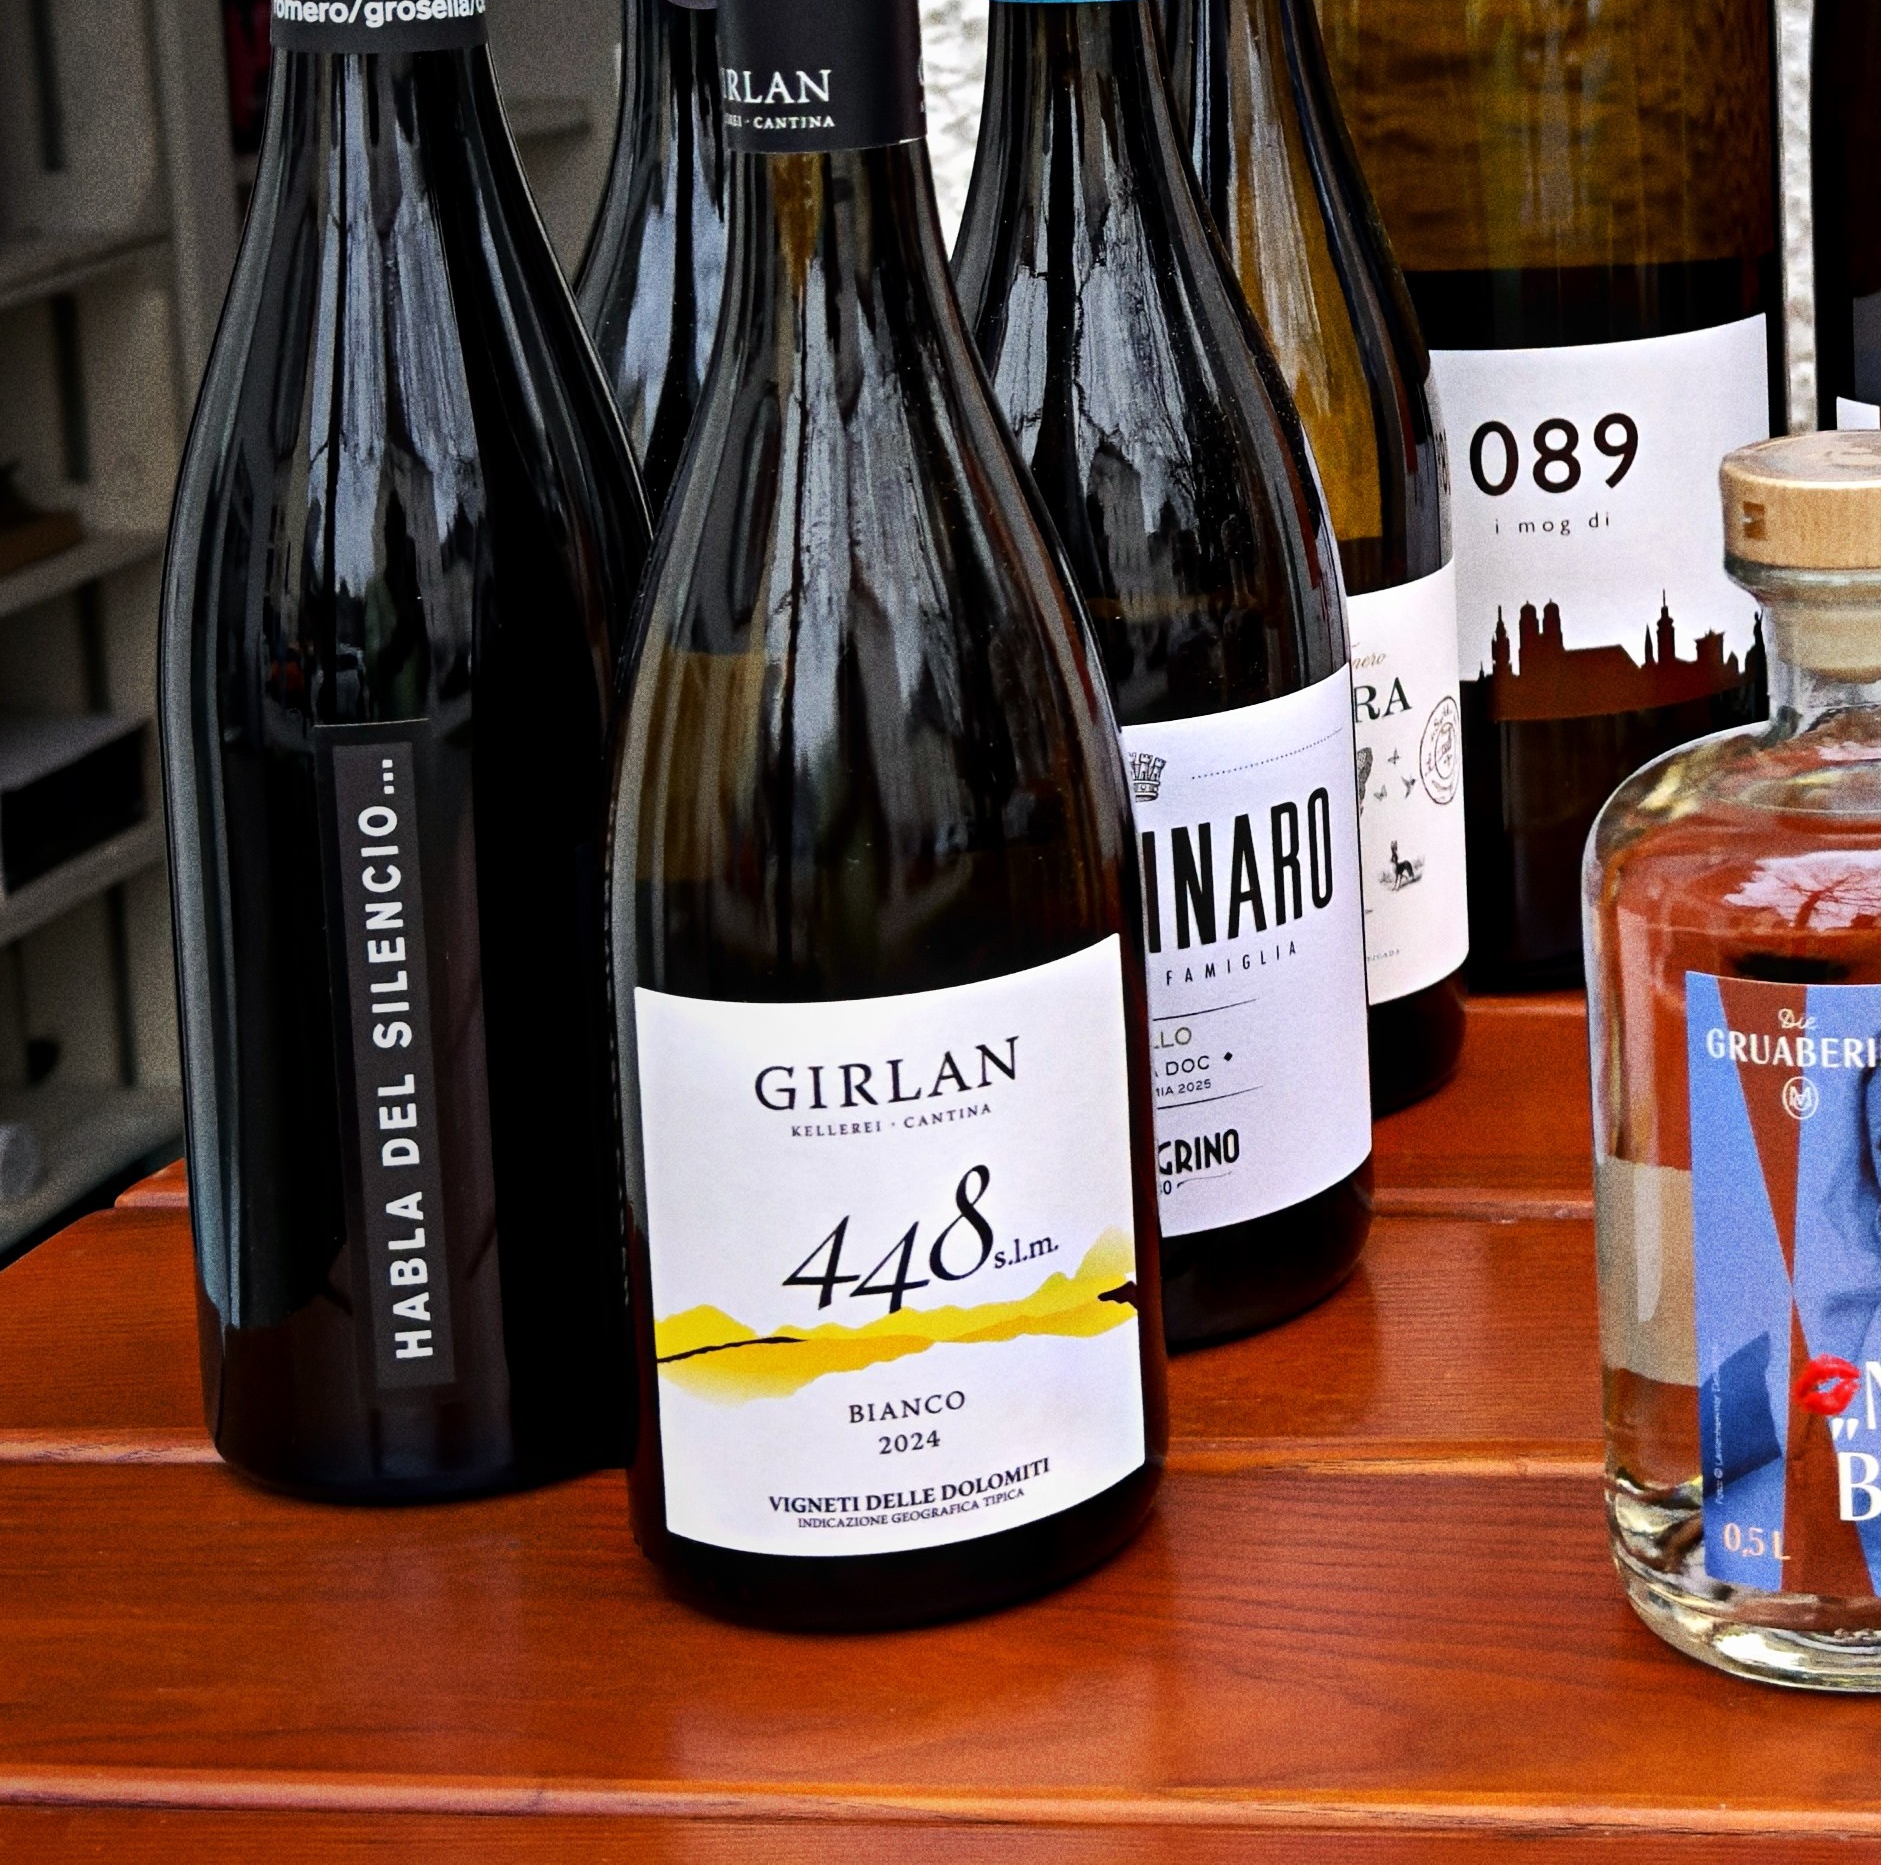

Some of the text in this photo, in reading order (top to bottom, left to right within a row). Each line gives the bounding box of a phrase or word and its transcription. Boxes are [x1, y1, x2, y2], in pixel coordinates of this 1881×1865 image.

[753, 115, 836, 130] CANTINA
[1469, 412, 1639, 497] 089
[1494, 511, 1609, 536] i mog di
[1141, 786, 1334, 954] INARO
[1166, 940, 1297, 986] FAMIGLIA
[1154, 1026, 1193, 1050] LO
[1778, 1008, 1818, 1030] Die
[754, 1035, 1020, 1111] GIRLAN
[1165, 1055, 1211, 1077] DOC
[1178, 1078, 1213, 1095] 2025
[377, 1073, 420, 1166] DEL
[791, 1103, 993, 1138] KELLEREI CANTINA
[1158, 1128, 1240, 1176] GRINO
[782, 1164, 1060, 1314] 448 s.l.m.
[385, 1191, 433, 1359] HABLA
[848, 1390, 966, 1424] BIANCO
[878, 1430, 941, 1455] 2024
[768, 1457, 1052, 1514] VIGNETI DELLE DOLOMITI
[798, 1486, 1026, 1529] INDICAZIONE GEOGRAFICA TIPICA
[1773, 1530, 1792, 1561] L
